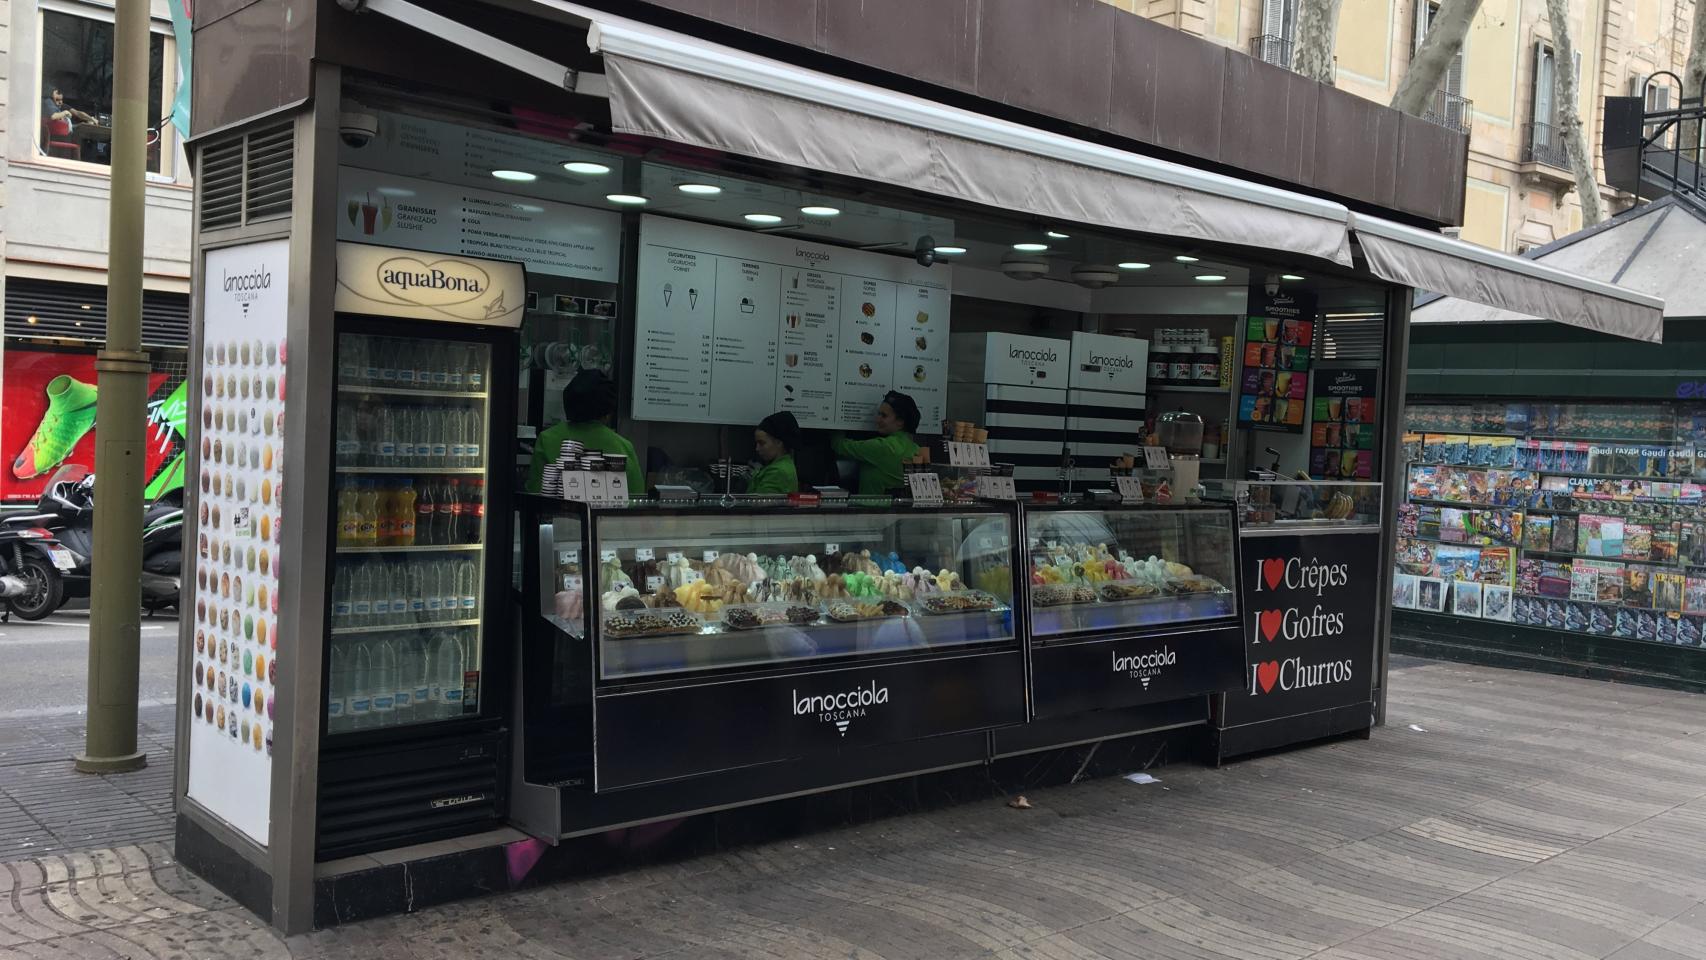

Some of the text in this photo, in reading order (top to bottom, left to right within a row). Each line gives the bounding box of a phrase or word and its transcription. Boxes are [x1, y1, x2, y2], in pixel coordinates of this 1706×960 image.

[397, 204, 436, 216] GRANISSAT
[397, 213, 437, 225] GRANIZADO
[397, 221, 423, 231] SLUSHIE
[224, 264, 271, 292] lanocciola
[384, 269, 480, 293] aquaBona
[234, 292, 258, 302] TOSCANA
[1265, 305, 1301, 315] SMOOTHIES
[1009, 343, 1056, 362] lanocciola
[1089, 350, 1134, 369] lanocciola
[1328, 385, 1363, 394] SMOOTHIES
[1569, 477, 1595, 487] CLARA
[1255, 557, 1348, 596] I Crêpes
[1252, 604, 1344, 644] I Gofres
[1112, 644, 1176, 672] lanocciola
[1130, 668, 1161, 679] TOSCANA
[1250, 656, 1352, 696] I Churros
[793, 679, 889, 715] lanocciola
[819, 708, 866, 722] TOSCANA
